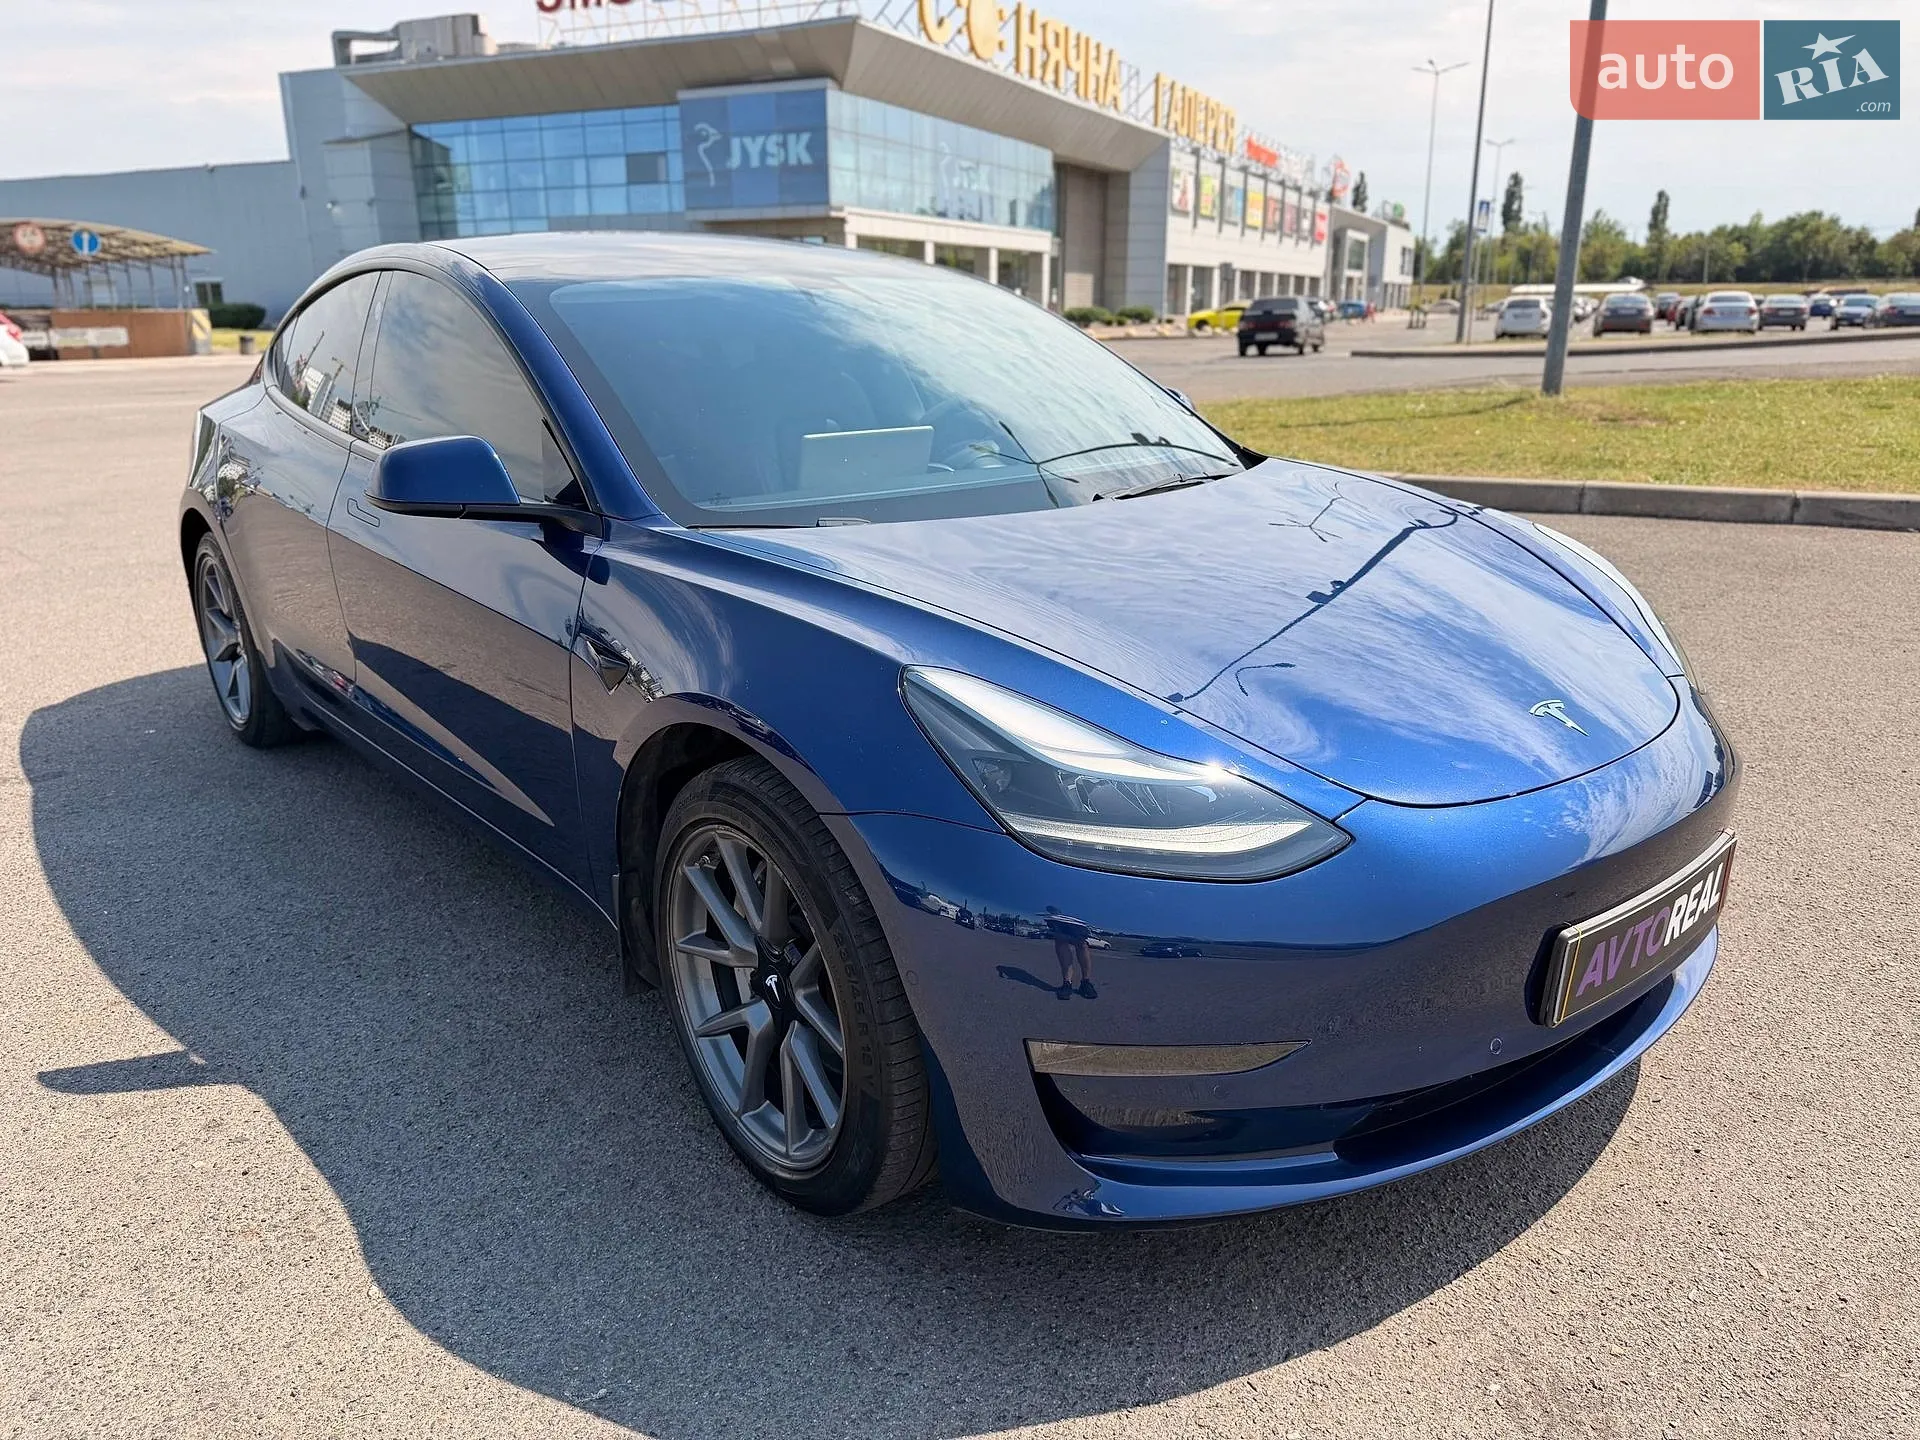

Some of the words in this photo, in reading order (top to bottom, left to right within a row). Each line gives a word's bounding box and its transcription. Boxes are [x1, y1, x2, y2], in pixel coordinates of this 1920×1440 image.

[726, 131, 814, 170] JYSK
[1154, 72, 1238, 154] ГАЛЕРЕЯ
[1576, 862, 1724, 998] AVTOREAL
